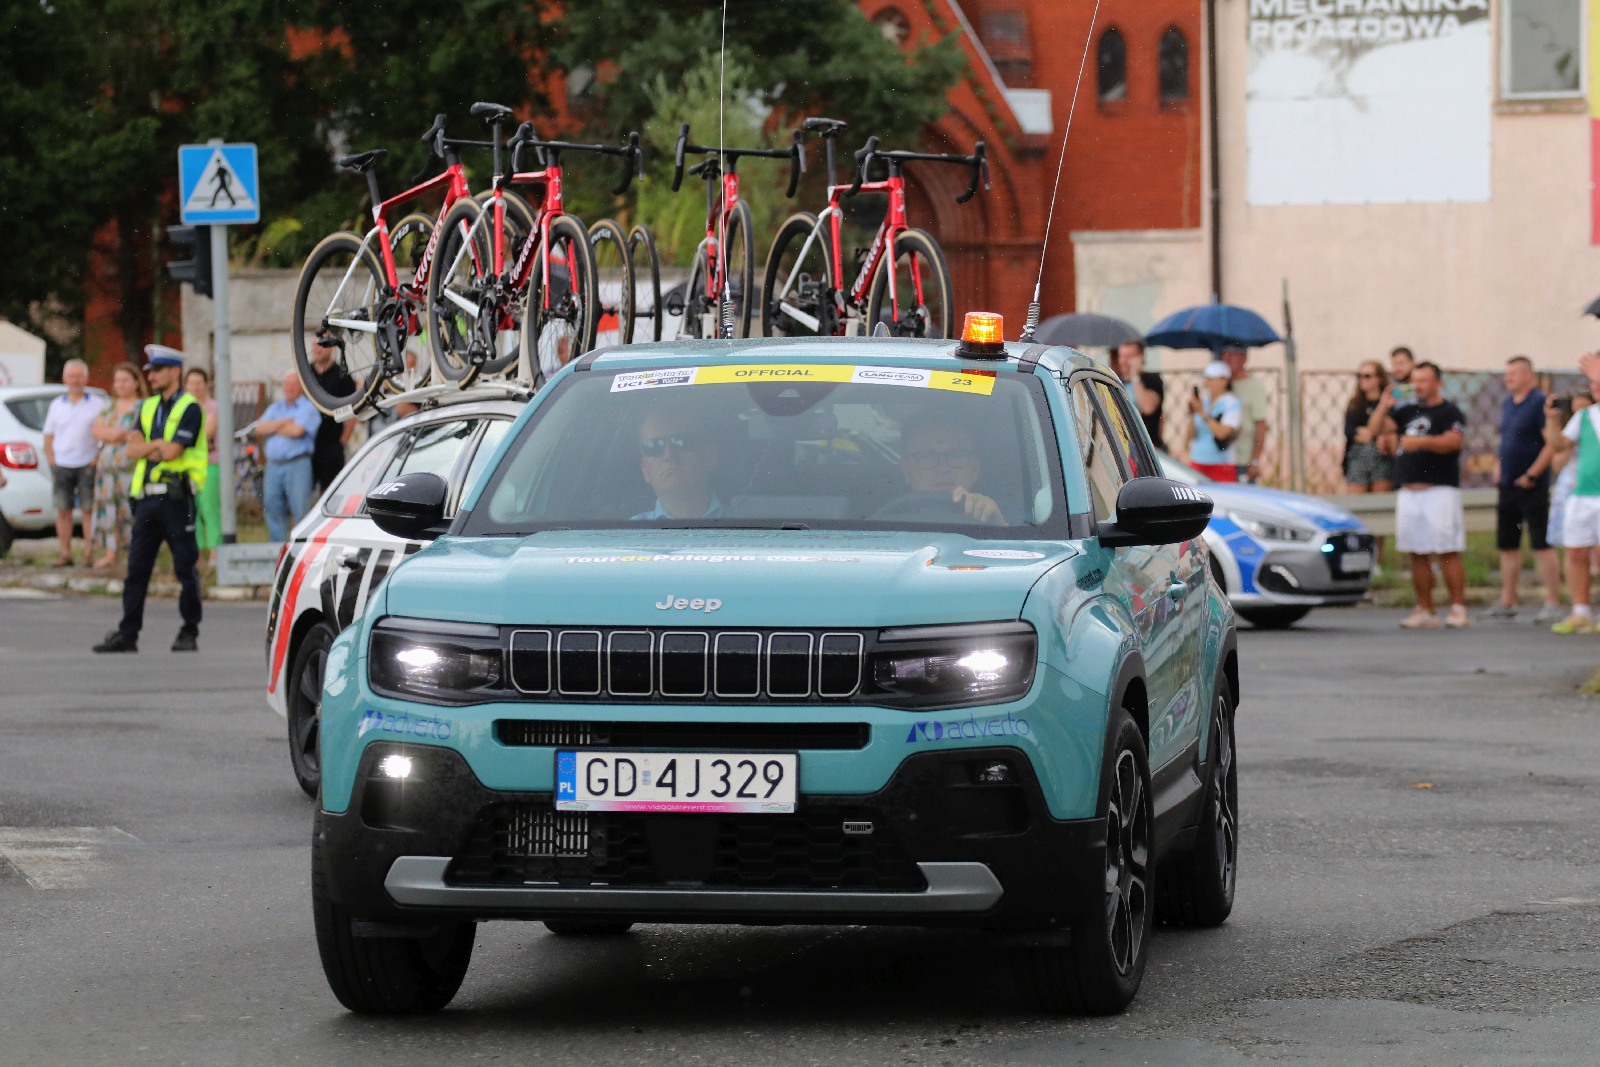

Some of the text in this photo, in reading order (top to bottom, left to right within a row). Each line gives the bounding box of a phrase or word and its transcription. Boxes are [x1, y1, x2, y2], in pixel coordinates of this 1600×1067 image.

[735, 369, 813, 377] OFFICIAL
[617, 381, 642, 389] UCI
[951, 378, 973, 386] 23
[655, 594, 722, 613] Jeep
[382, 710, 451, 740] adverto
[947, 711, 1030, 740] adverto
[586, 758, 785, 799] GD 4J329
[559, 782, 574, 793] PL
